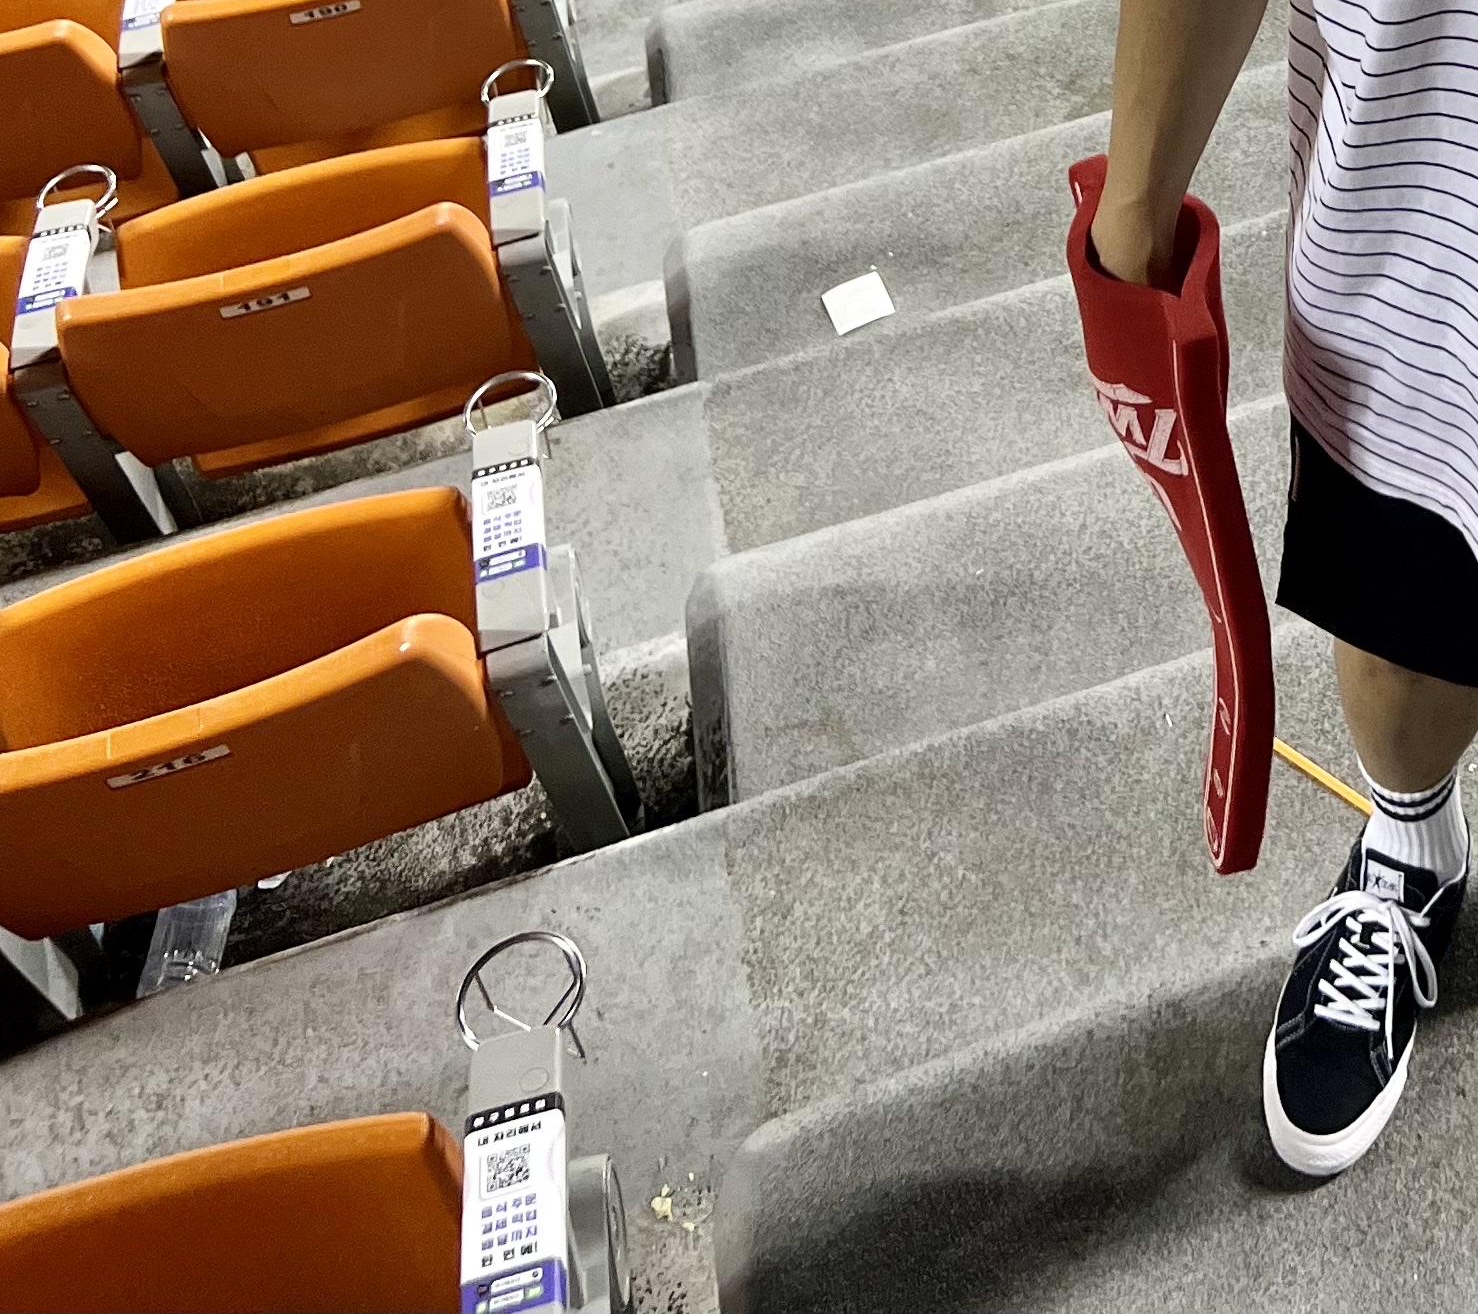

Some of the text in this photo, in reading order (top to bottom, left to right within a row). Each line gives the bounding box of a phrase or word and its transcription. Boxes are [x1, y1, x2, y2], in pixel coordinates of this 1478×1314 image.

[306, 3, 347, 21] 190
[239, 293, 291, 313] 191
[132, 754, 206, 781] 216
